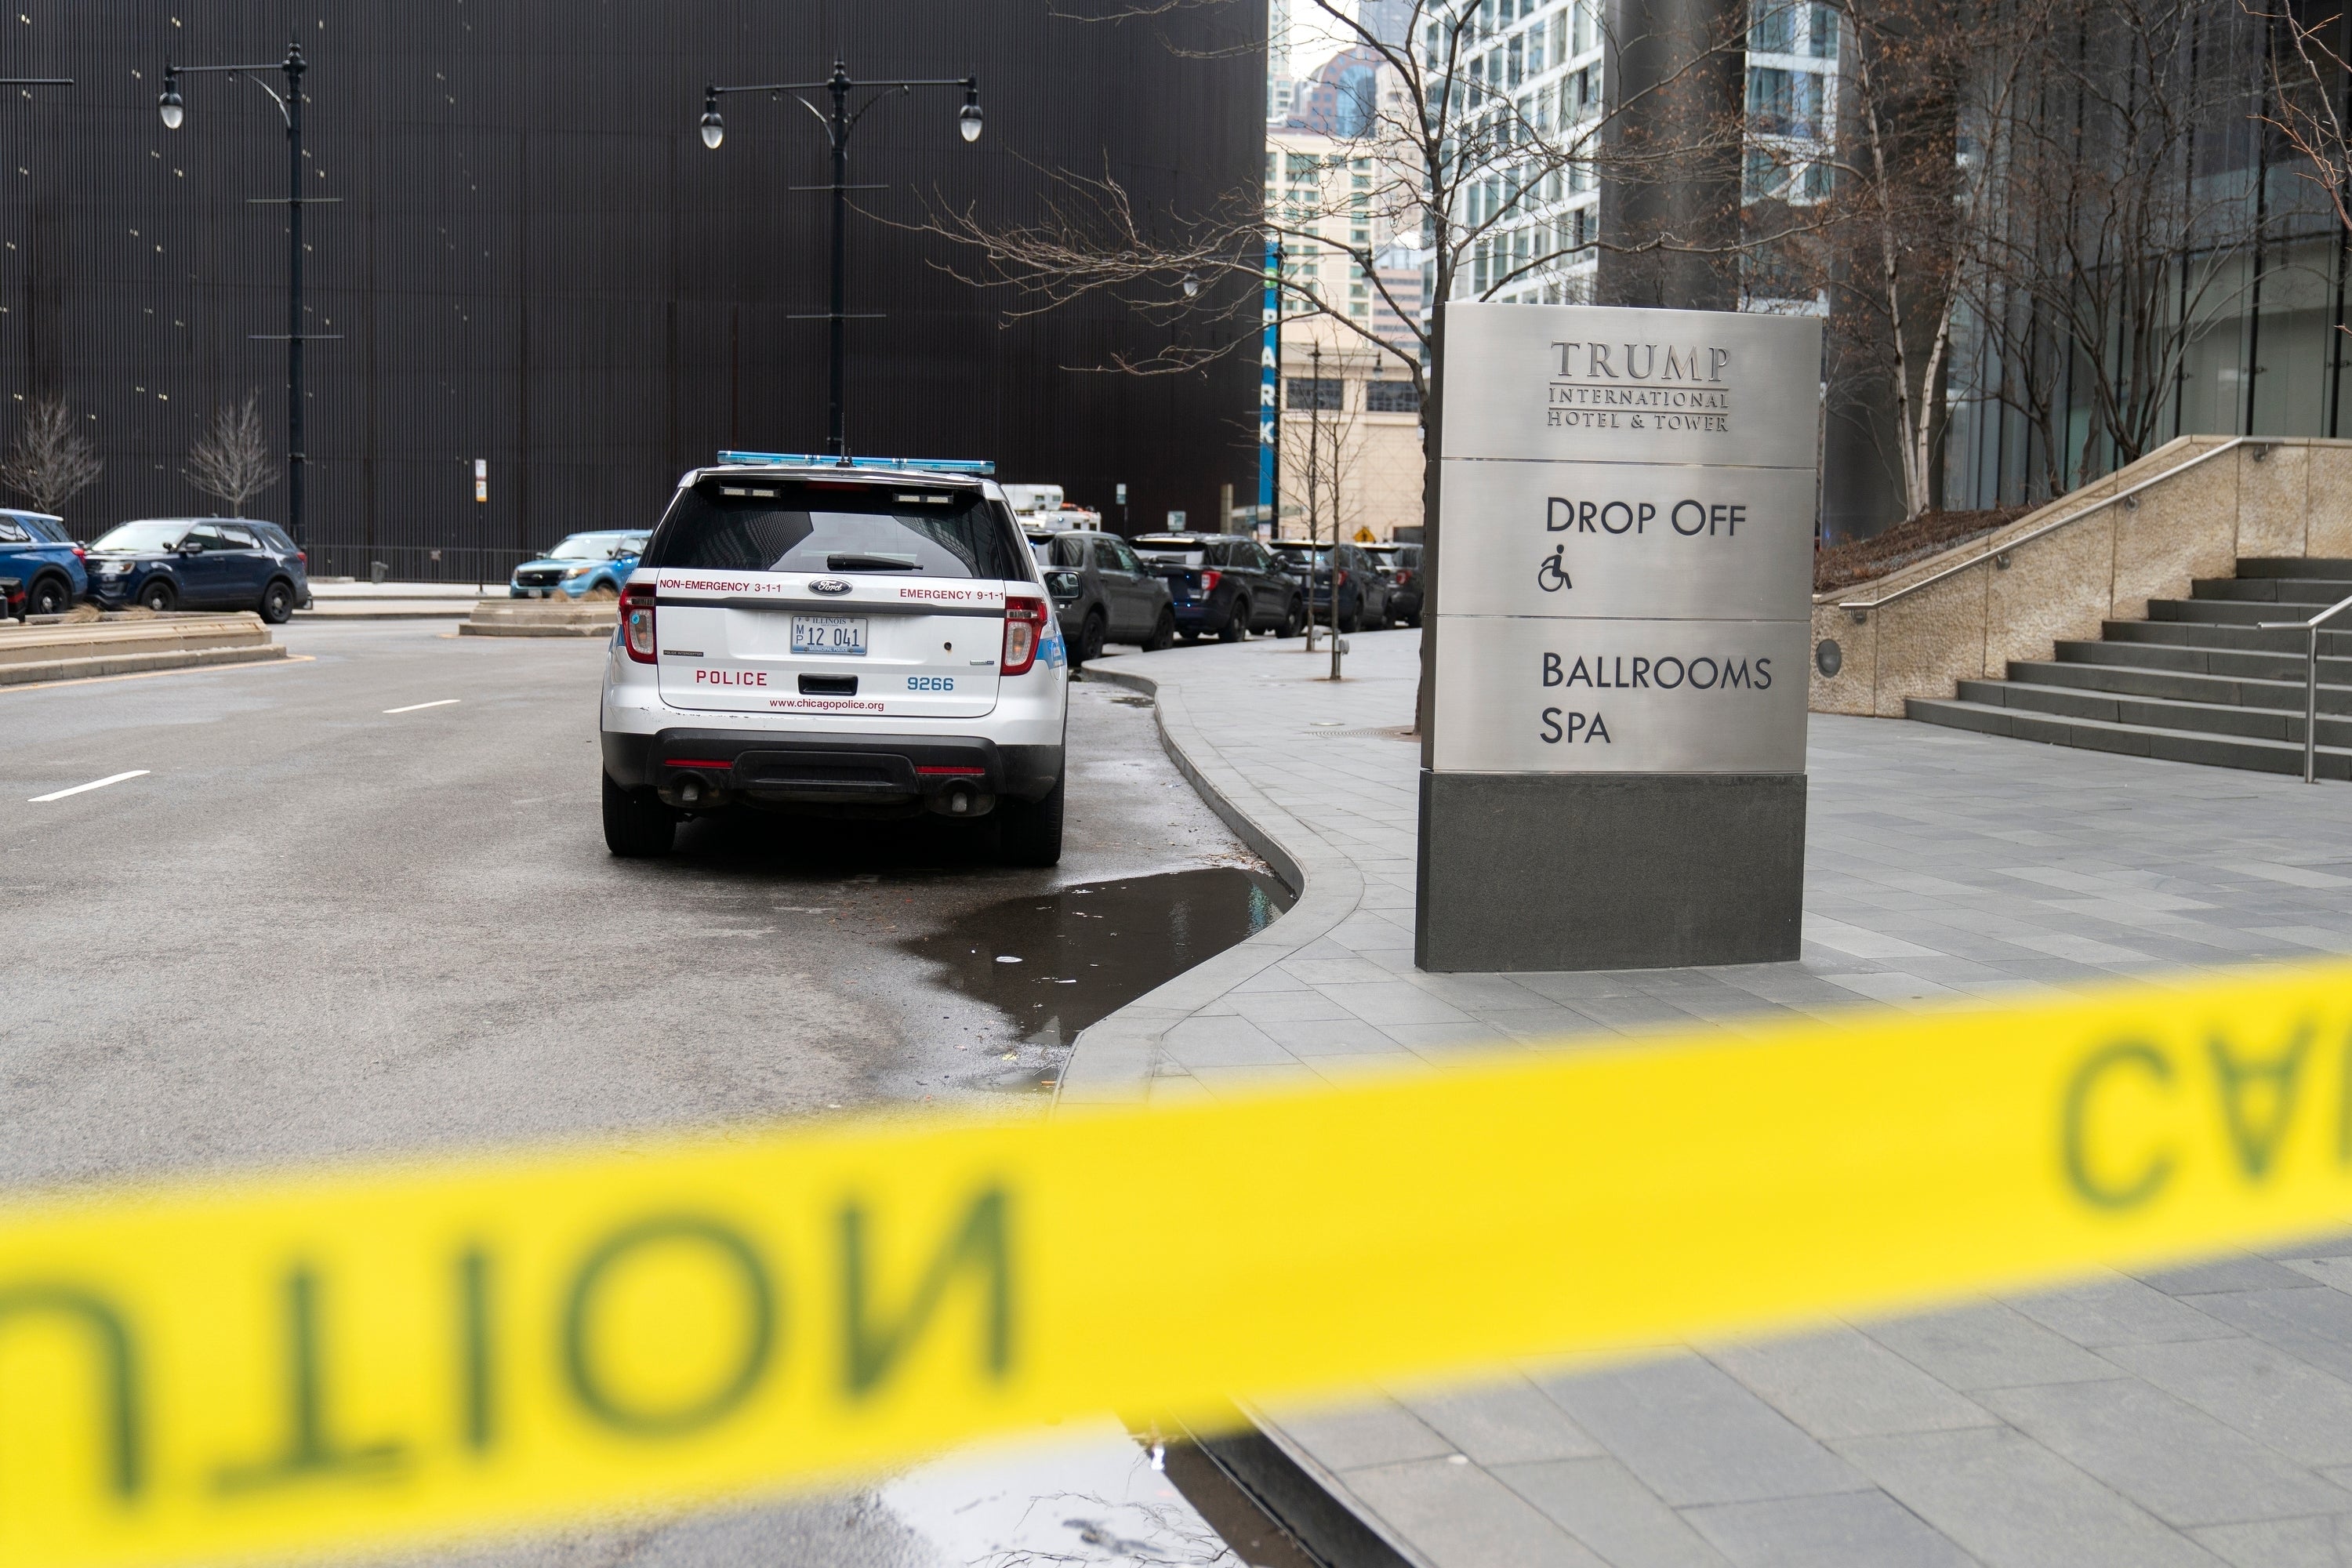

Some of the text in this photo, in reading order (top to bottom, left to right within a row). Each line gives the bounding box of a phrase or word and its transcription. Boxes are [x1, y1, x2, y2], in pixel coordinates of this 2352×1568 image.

[1551, 340, 1731, 382] TRUMP
[1548, 387, 1730, 408] INTERNATIONAL
[1547, 411, 1729, 432] HOTEL & TOWER
[1547, 496, 1747, 536] DROP OFF
[659, 579, 782, 593] NON-EMERGENCY 3-1-1
[818, 580, 843, 593] Ford
[900, 588, 1004, 601] EMERGENCY 9-1-1
[807, 627, 860, 647] 12 041
[696, 670, 768, 686] POLICE
[1542, 652, 1773, 690] BALLROOMS
[907, 677, 954, 691] 9266
[769, 699, 884, 712] www.chicagopolice.org
[1539, 706, 1611, 744] SPA
